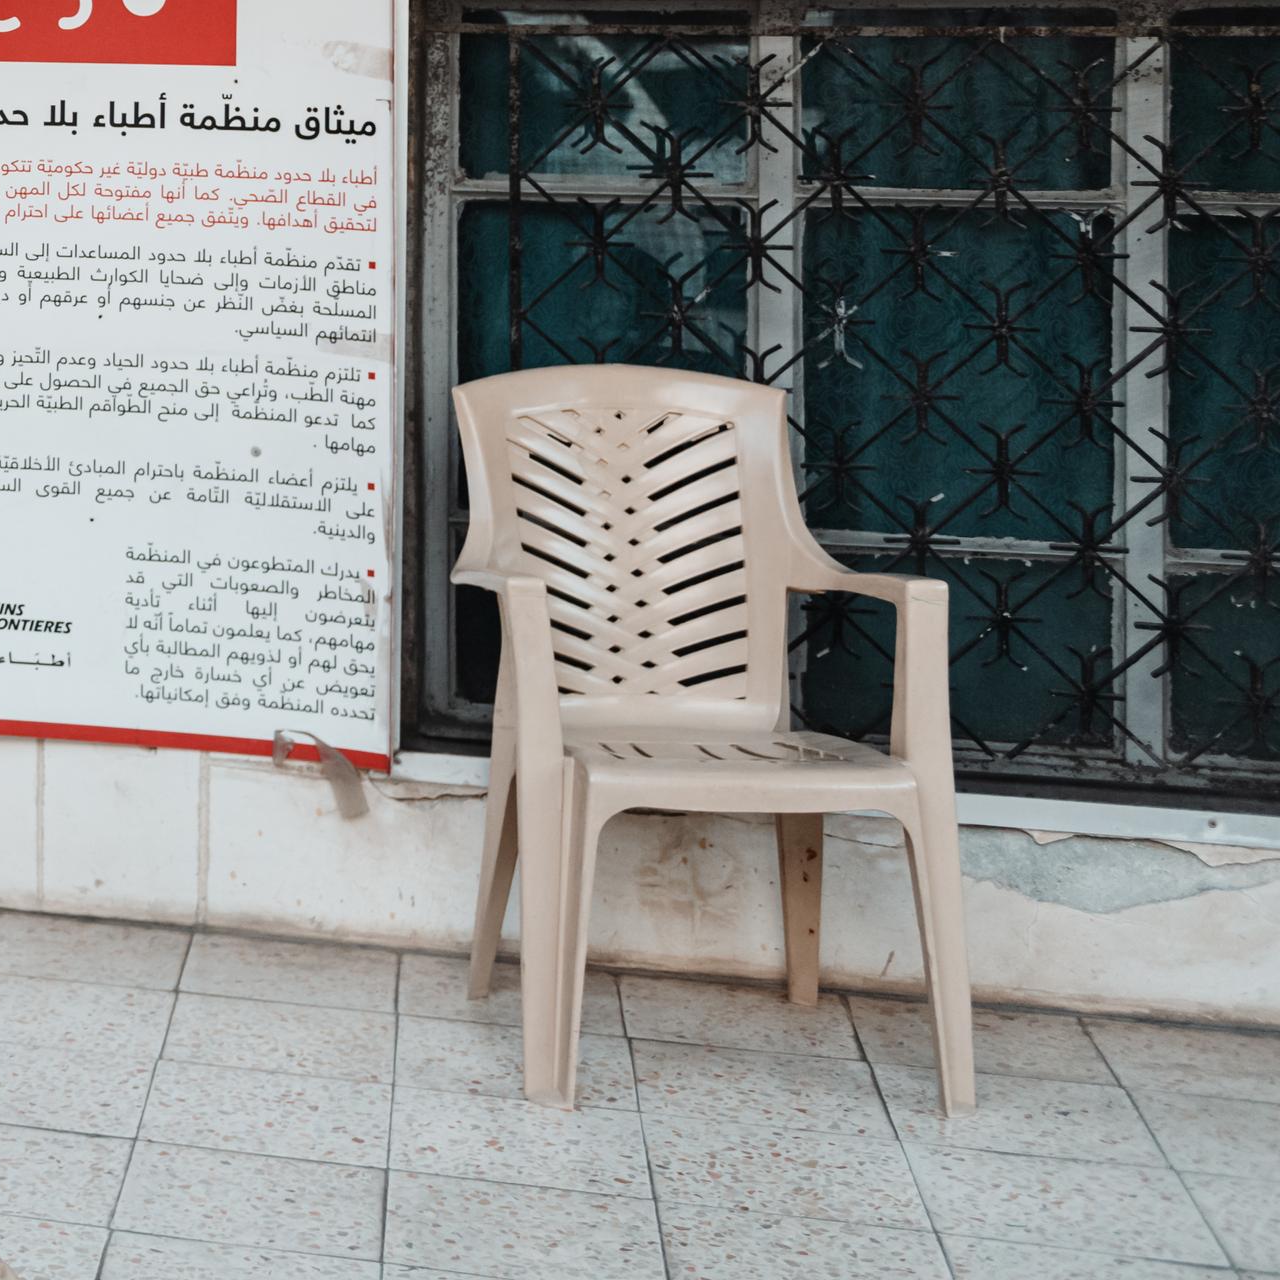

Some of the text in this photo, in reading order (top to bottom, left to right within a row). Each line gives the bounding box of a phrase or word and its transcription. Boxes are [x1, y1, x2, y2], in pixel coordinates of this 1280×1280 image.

[43, 99, 78, 136] بلا
[92, 91, 167, 137] أطباء
[294, 98, 377, 145] ميثاق
[274, 172, 312, 185] حدود
[317, 167, 336, 187] بلا
[54, 204, 84, 223] على
[353, 199, 377, 216] في
[25, 242, 50, 262] إلى
[148, 252, 186, 266] حدود
[193, 248, 212, 267] بلا
[183, 298, 206, 313] عن
[148, 490, 172, 505] عن
[345, 501, 375, 520] على
[196, 553, 222, 574] في
